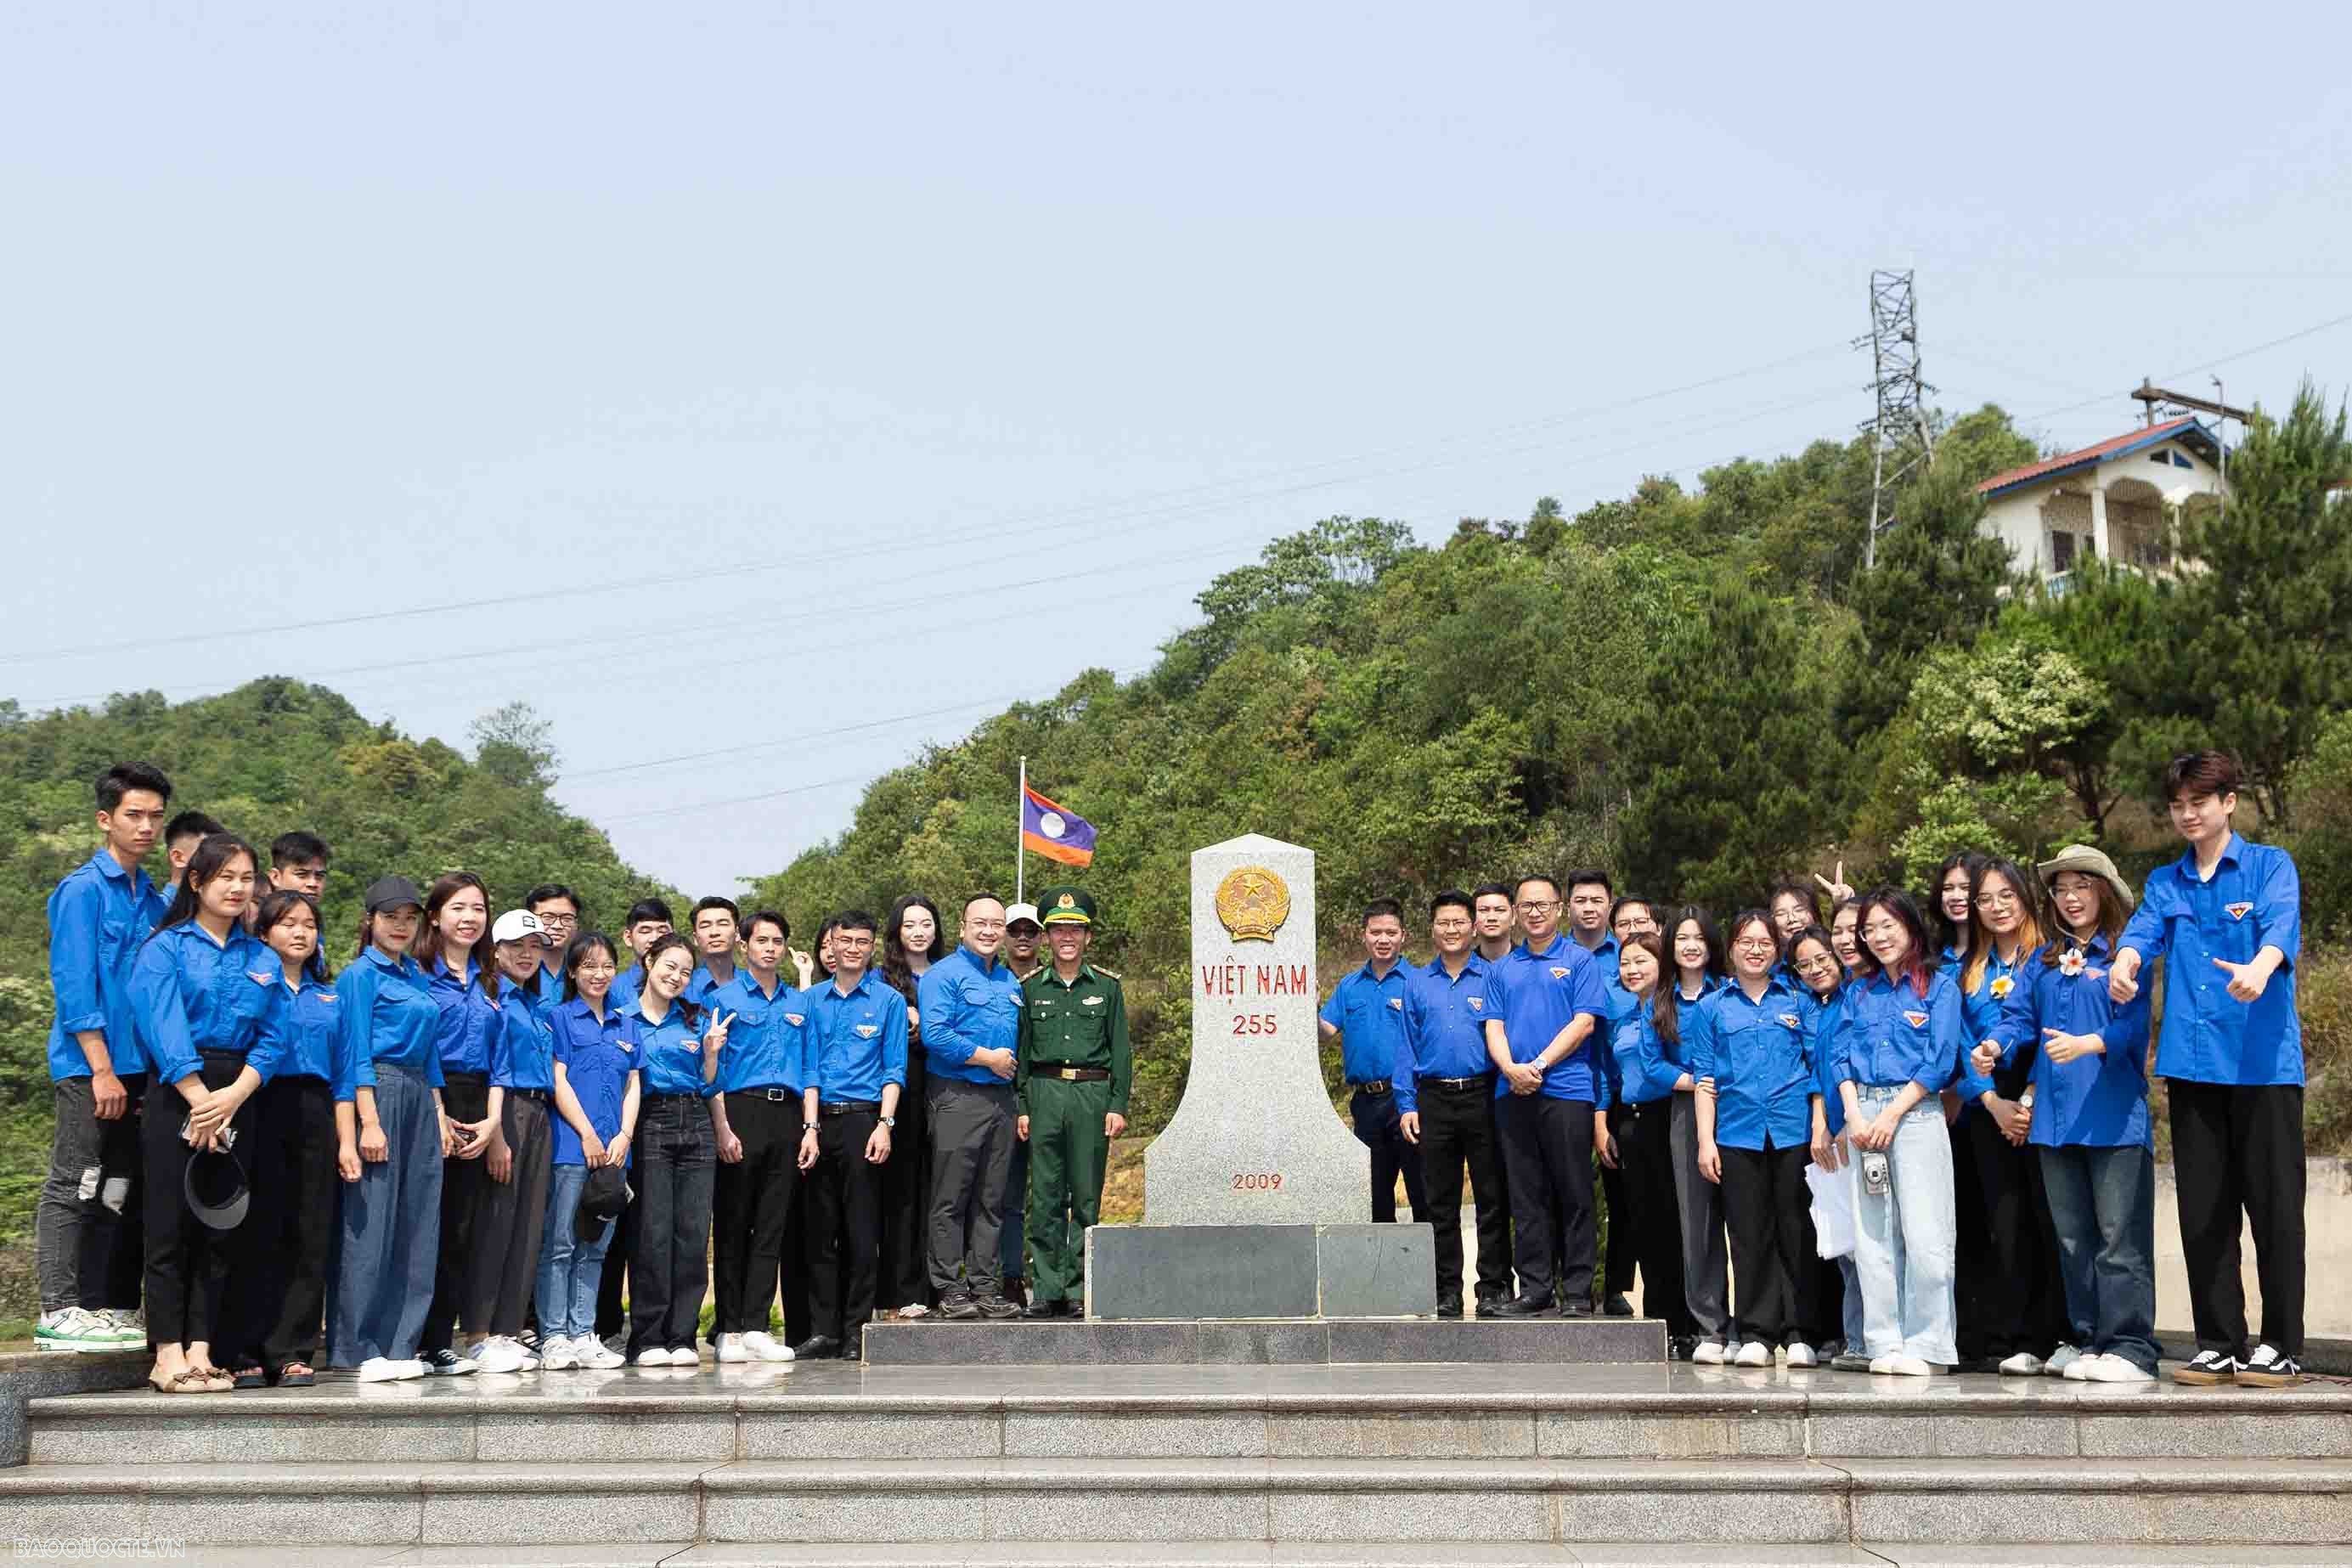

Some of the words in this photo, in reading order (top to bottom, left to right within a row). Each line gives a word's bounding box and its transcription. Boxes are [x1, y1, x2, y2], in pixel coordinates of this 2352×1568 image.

[1202, 955, 1246, 1005] VIỆT
[1257, 964, 1306, 995] NAM
[1232, 1014, 1278, 1035] 255
[1232, 1174, 1282, 1190] 2009
